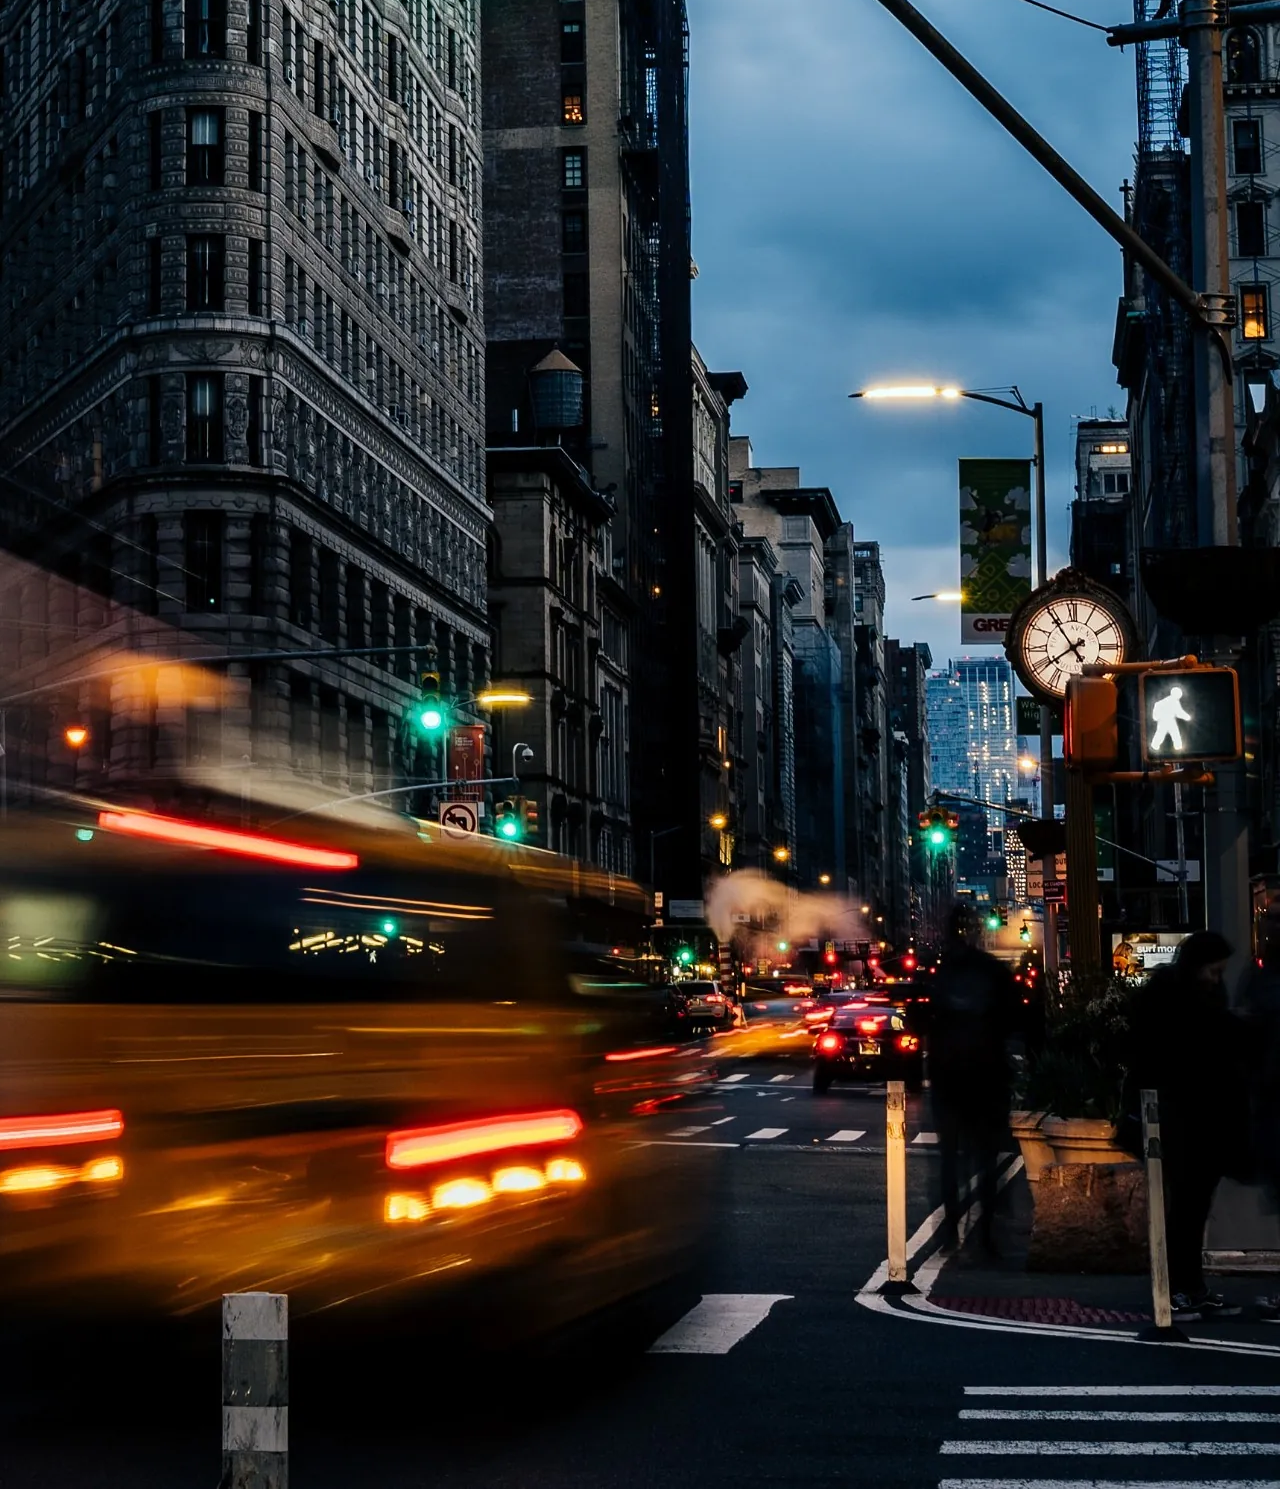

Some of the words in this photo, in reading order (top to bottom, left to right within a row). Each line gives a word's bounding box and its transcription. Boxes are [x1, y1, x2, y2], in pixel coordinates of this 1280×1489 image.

[973, 618, 1010, 632] GRE
[1136, 944, 1156, 953] surf
[1157, 945, 1177, 953] mor
